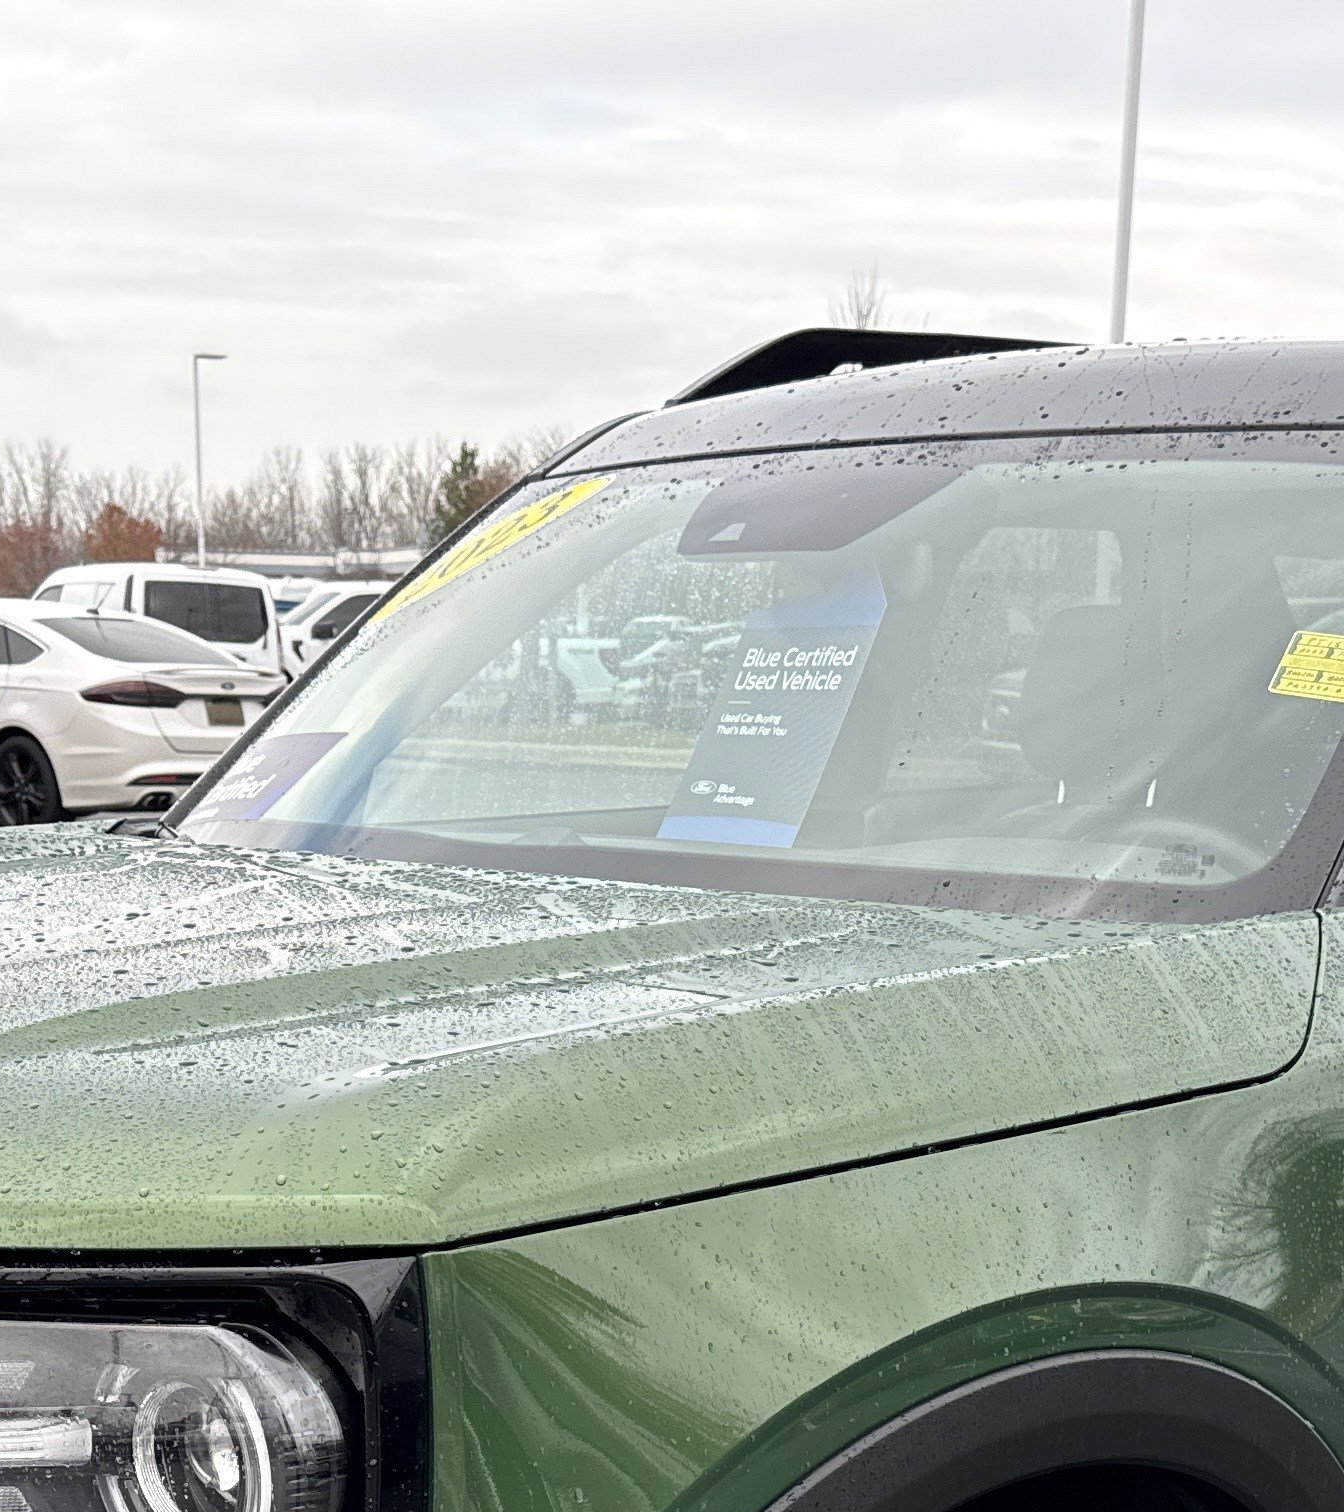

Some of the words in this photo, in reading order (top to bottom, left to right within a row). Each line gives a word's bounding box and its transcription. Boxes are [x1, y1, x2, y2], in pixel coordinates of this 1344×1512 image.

[742, 647, 782, 668] Blue
[783, 645, 859, 667] Certified
[734, 670, 781, 690] Used
[782, 670, 842, 691] Vehicle
[720, 713, 741, 723] Used
